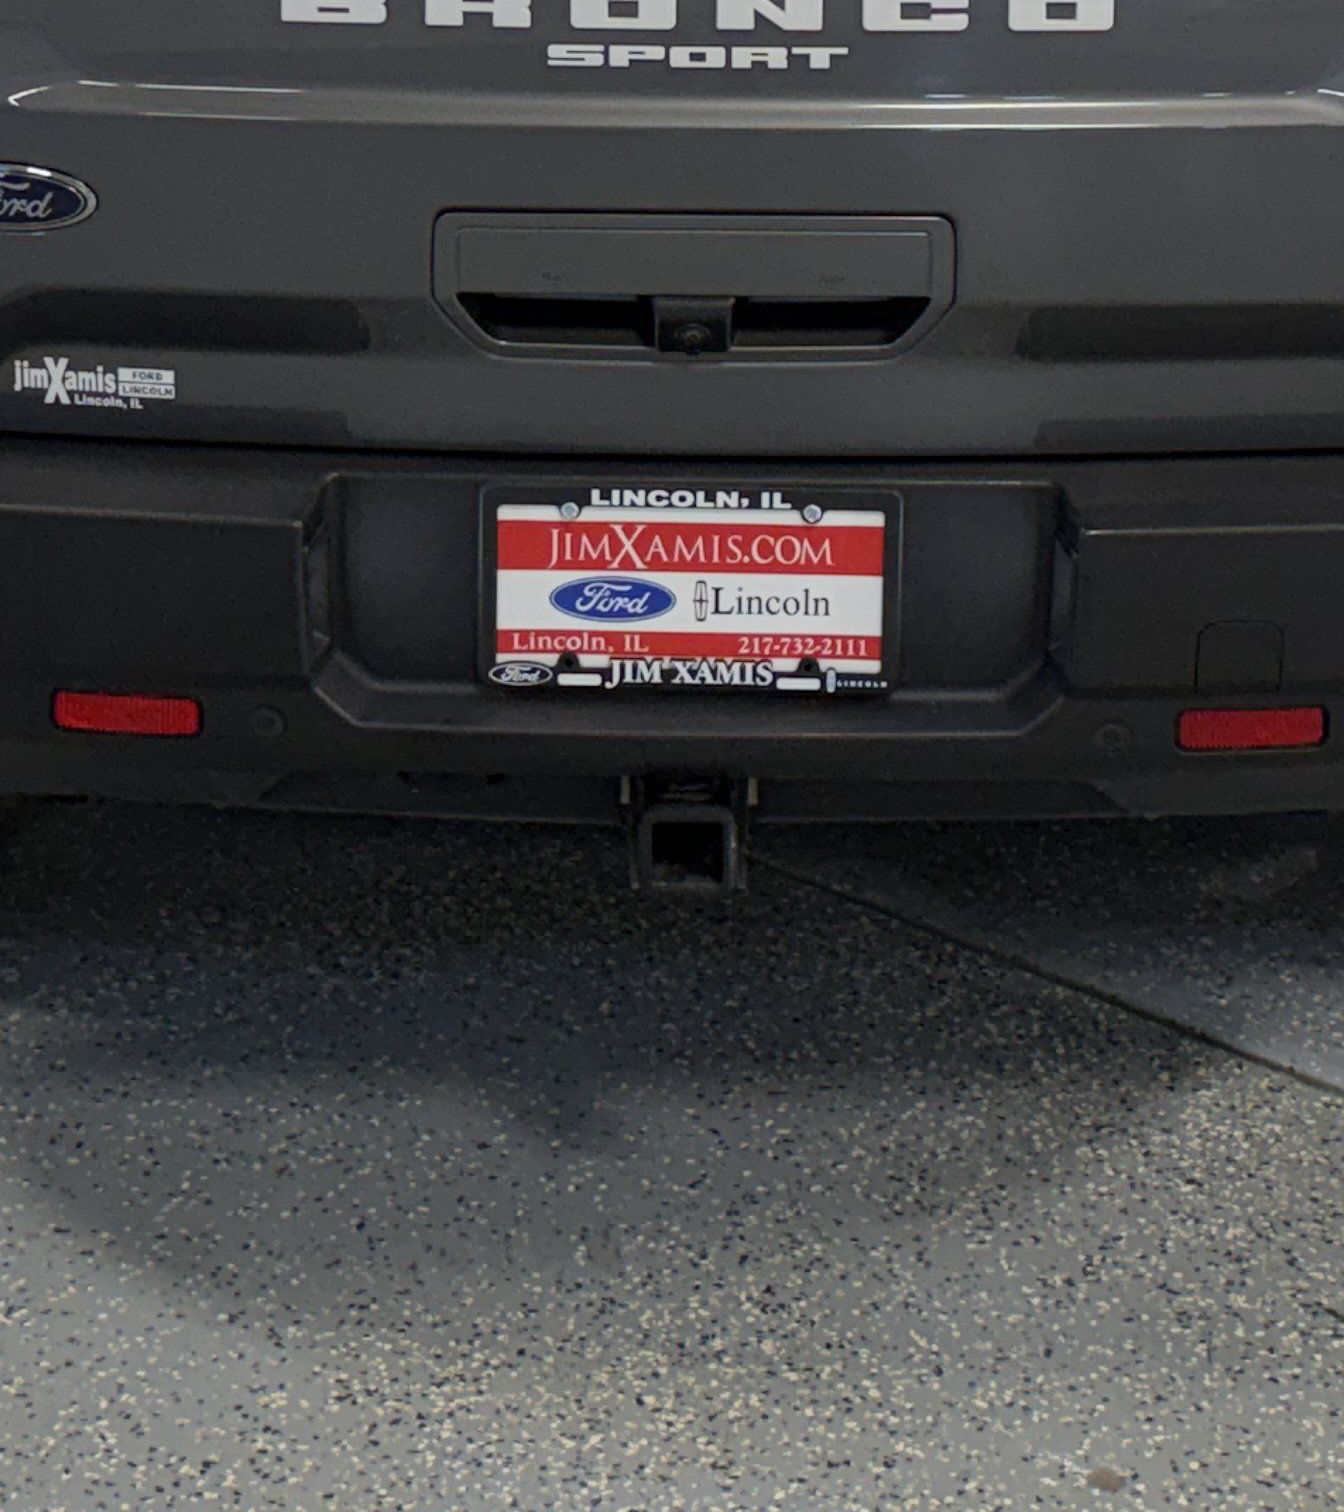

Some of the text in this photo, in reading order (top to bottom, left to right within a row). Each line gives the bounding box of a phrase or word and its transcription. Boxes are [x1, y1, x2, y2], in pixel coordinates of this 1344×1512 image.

[546, 42, 850, 71] SPORT
[590, 488, 792, 509] LINCOLN, IL
[575, 582, 651, 614] Ford
[711, 586, 830, 616] Lincoln
[624, 635, 649, 652] IL
[738, 636, 867, 657] 217-732-2111
[501, 666, 541, 683] Ford
[604, 659, 774, 689] JIM XAMIS
